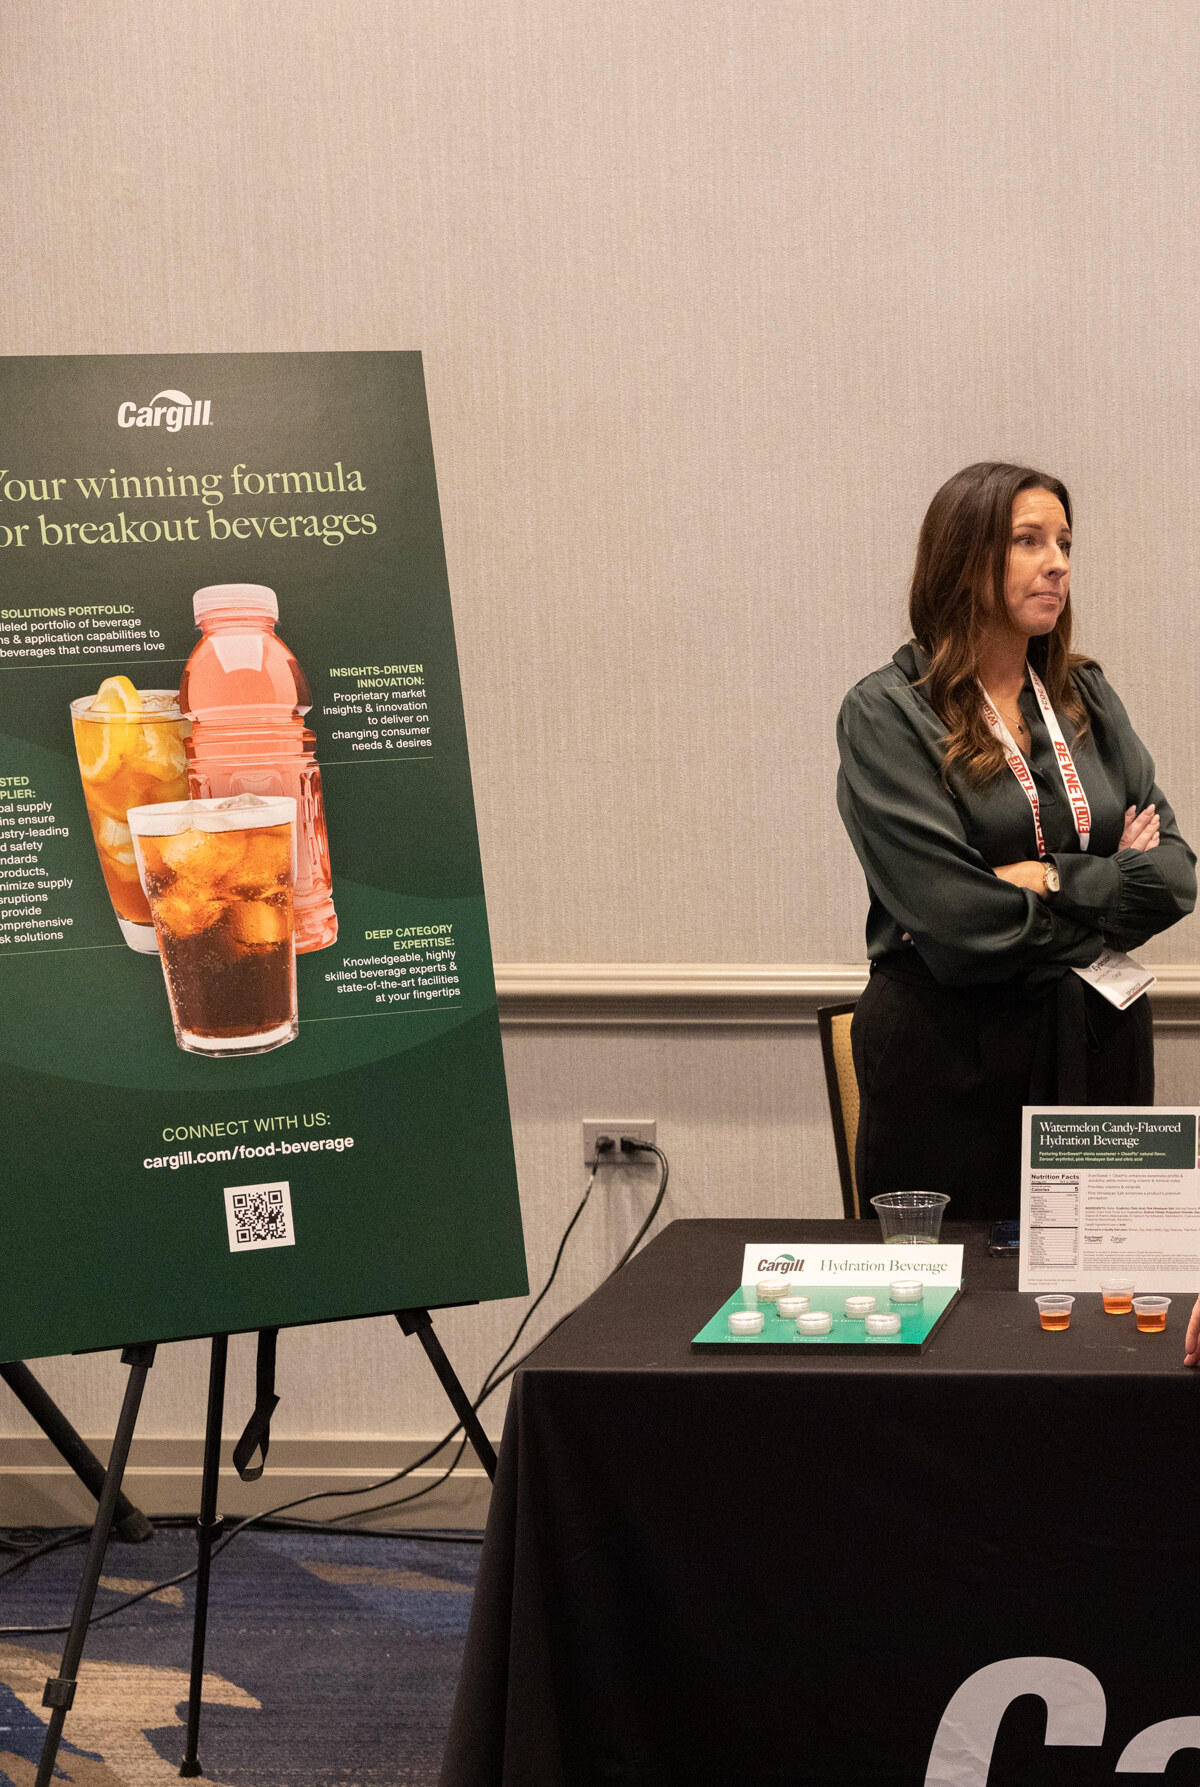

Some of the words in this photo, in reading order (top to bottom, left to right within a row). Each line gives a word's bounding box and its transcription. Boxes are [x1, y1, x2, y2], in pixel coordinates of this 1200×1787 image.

[117, 399, 211, 432] Cargill
[74, 466, 223, 505] winning
[230, 461, 366, 494] formula
[37, 511, 200, 545] breakout
[206, 509, 376, 545] beverages
[1, 608, 66, 619] SOLUTIONS
[68, 604, 135, 616] PORTFOLIO:
[30, 619, 75, 632] portfolio
[78, 618, 89, 628] of
[92, 618, 141, 628] beverage
[12, 634, 21, 643] &
[24, 632, 83, 645] application
[86, 629, 146, 642] capabilities
[149, 629, 159, 637] to
[0, 647, 55, 658] beverages
[58, 645, 80, 654] that
[82, 643, 141, 653] consumers
[143, 641, 164, 650] love
[329, 664, 423, 677] INSIGHTS-DRIVEN
[357, 676, 425, 688] INNOVATION:
[333, 691, 388, 702] Proprietary
[391, 688, 426, 698] market
[323, 704, 362, 716] insights
[365, 703, 373, 712] &
[375, 701, 427, 711] innovation
[367, 716, 377, 724] to
[380, 714, 413, 724] deliver
[416, 714, 428, 722] on
[332, 729, 378, 740] changing
[381, 727, 430, 736] consumer
[352, 740, 382, 750] needs
[385, 739, 393, 748] &
[396, 738, 431, 748] desires
[365, 929, 393, 940] DEEP
[395, 924, 453, 938] CATEGORY
[393, 937, 455, 951] EXPERTISE:
[343, 952, 423, 966] Knowledgeable,
[426, 949, 455, 961] highly
[325, 970, 357, 981] skilled
[359, 967, 406, 978] beverage
[409, 963, 446, 975] experts
[449, 961, 457, 970] &
[337, 978, 415, 992] state-of-the-art
[417, 975, 459, 985] facilities
[375, 993, 385, 1002] at
[387, 992, 410, 1003] your
[412, 987, 460, 1000] fingertips
[162, 1120, 248, 1141] CONNECT
[253, 1115, 297, 1131] WITH
[303, 1112, 330, 1127] US:
[1040, 1121, 1100, 1133] Watermelon
[1102, 1122, 1181, 1135] Candy-Flavored
[1040, 1135, 1091, 1148] Hydration
[1093, 1135, 1140, 1148] Beverage
[143, 1137, 353, 1169] cargill.com/food-beverage
[1031, 1173, 1060, 1181] Nutrition
[1061, 1173, 1080, 1181] Facts
[757, 1258, 805, 1275] Cargill
[820, 1259, 885, 1273] Hydration
[889, 1259, 948, 1275] Beverage
